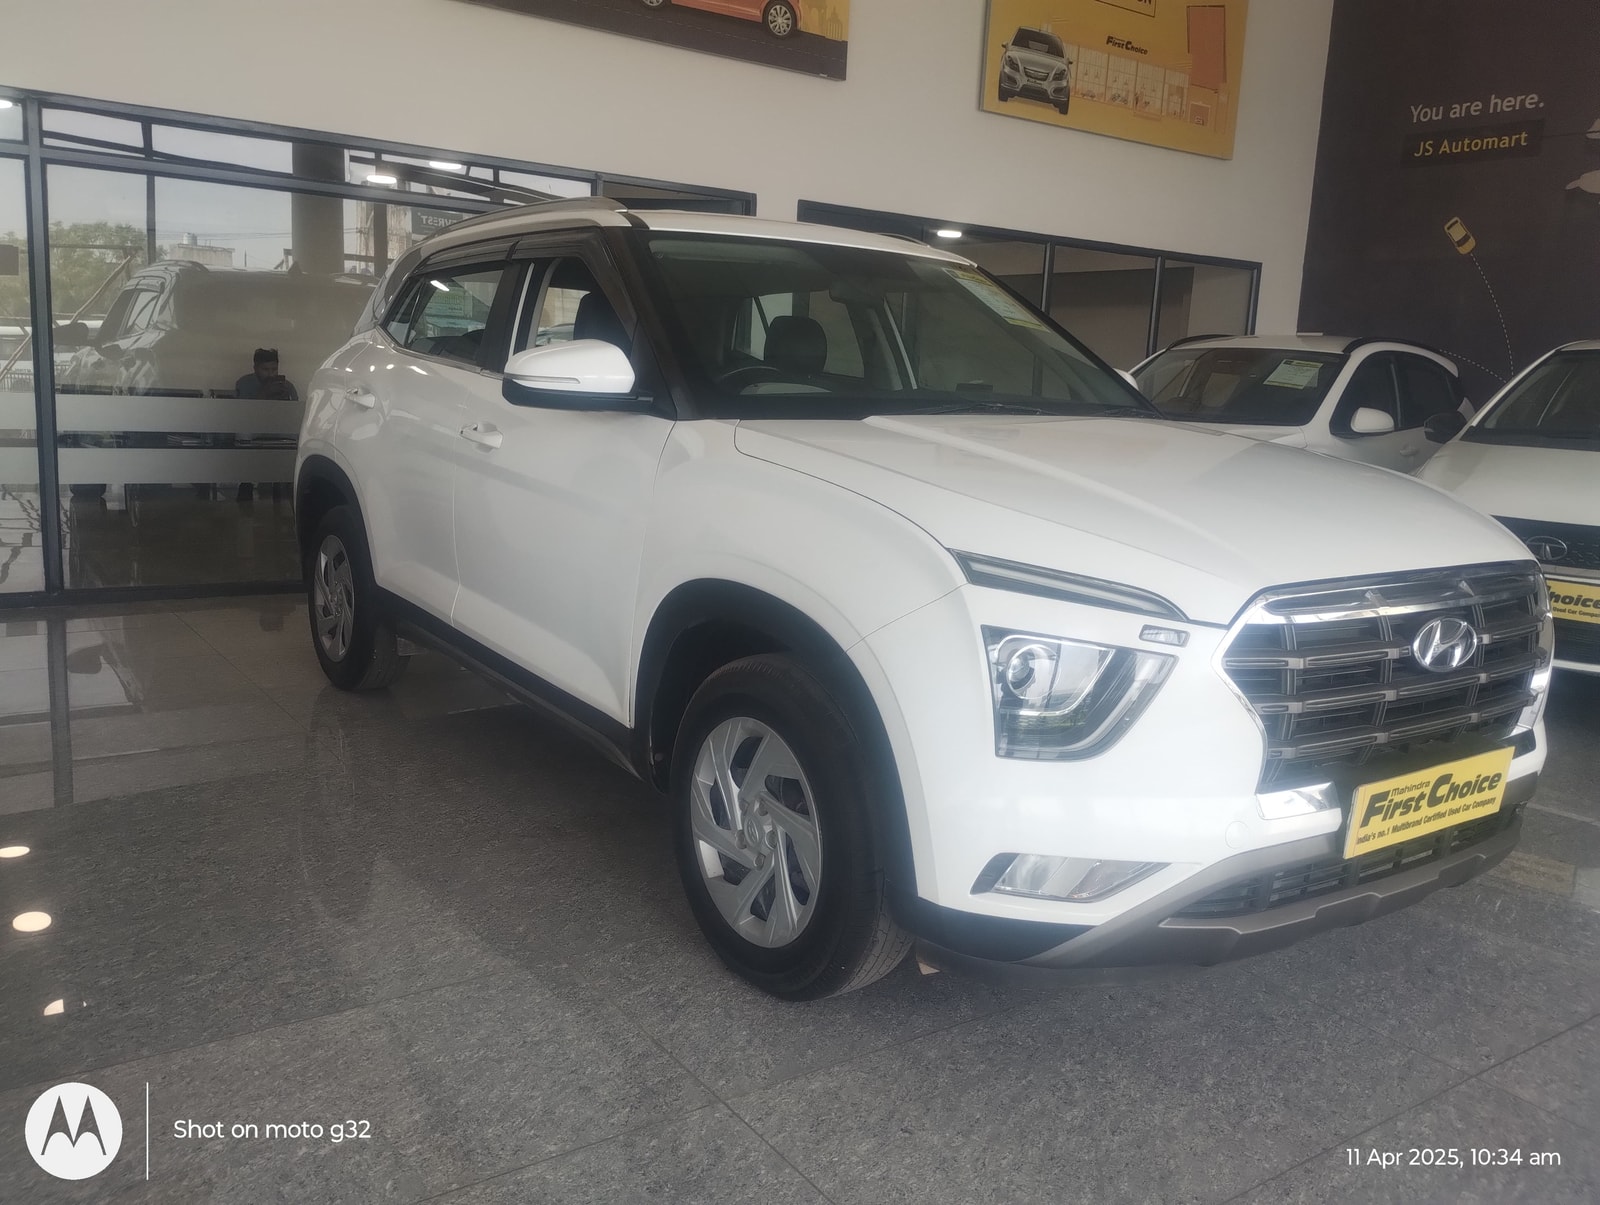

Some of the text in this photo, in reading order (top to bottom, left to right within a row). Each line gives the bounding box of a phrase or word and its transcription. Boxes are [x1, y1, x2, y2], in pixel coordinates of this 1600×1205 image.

[1410, 93, 1545, 123] You are here.
[1414, 131, 1528, 157] JS Automart
[1391, 780, 1430, 797] Mahindra
[1391, 816, 1423, 834] Multibrand
[1423, 809, 1448, 824] Certified
[1447, 806, 1461, 817] Used
[1462, 804, 1471, 812] Car
[1472, 797, 1496, 810] Company
